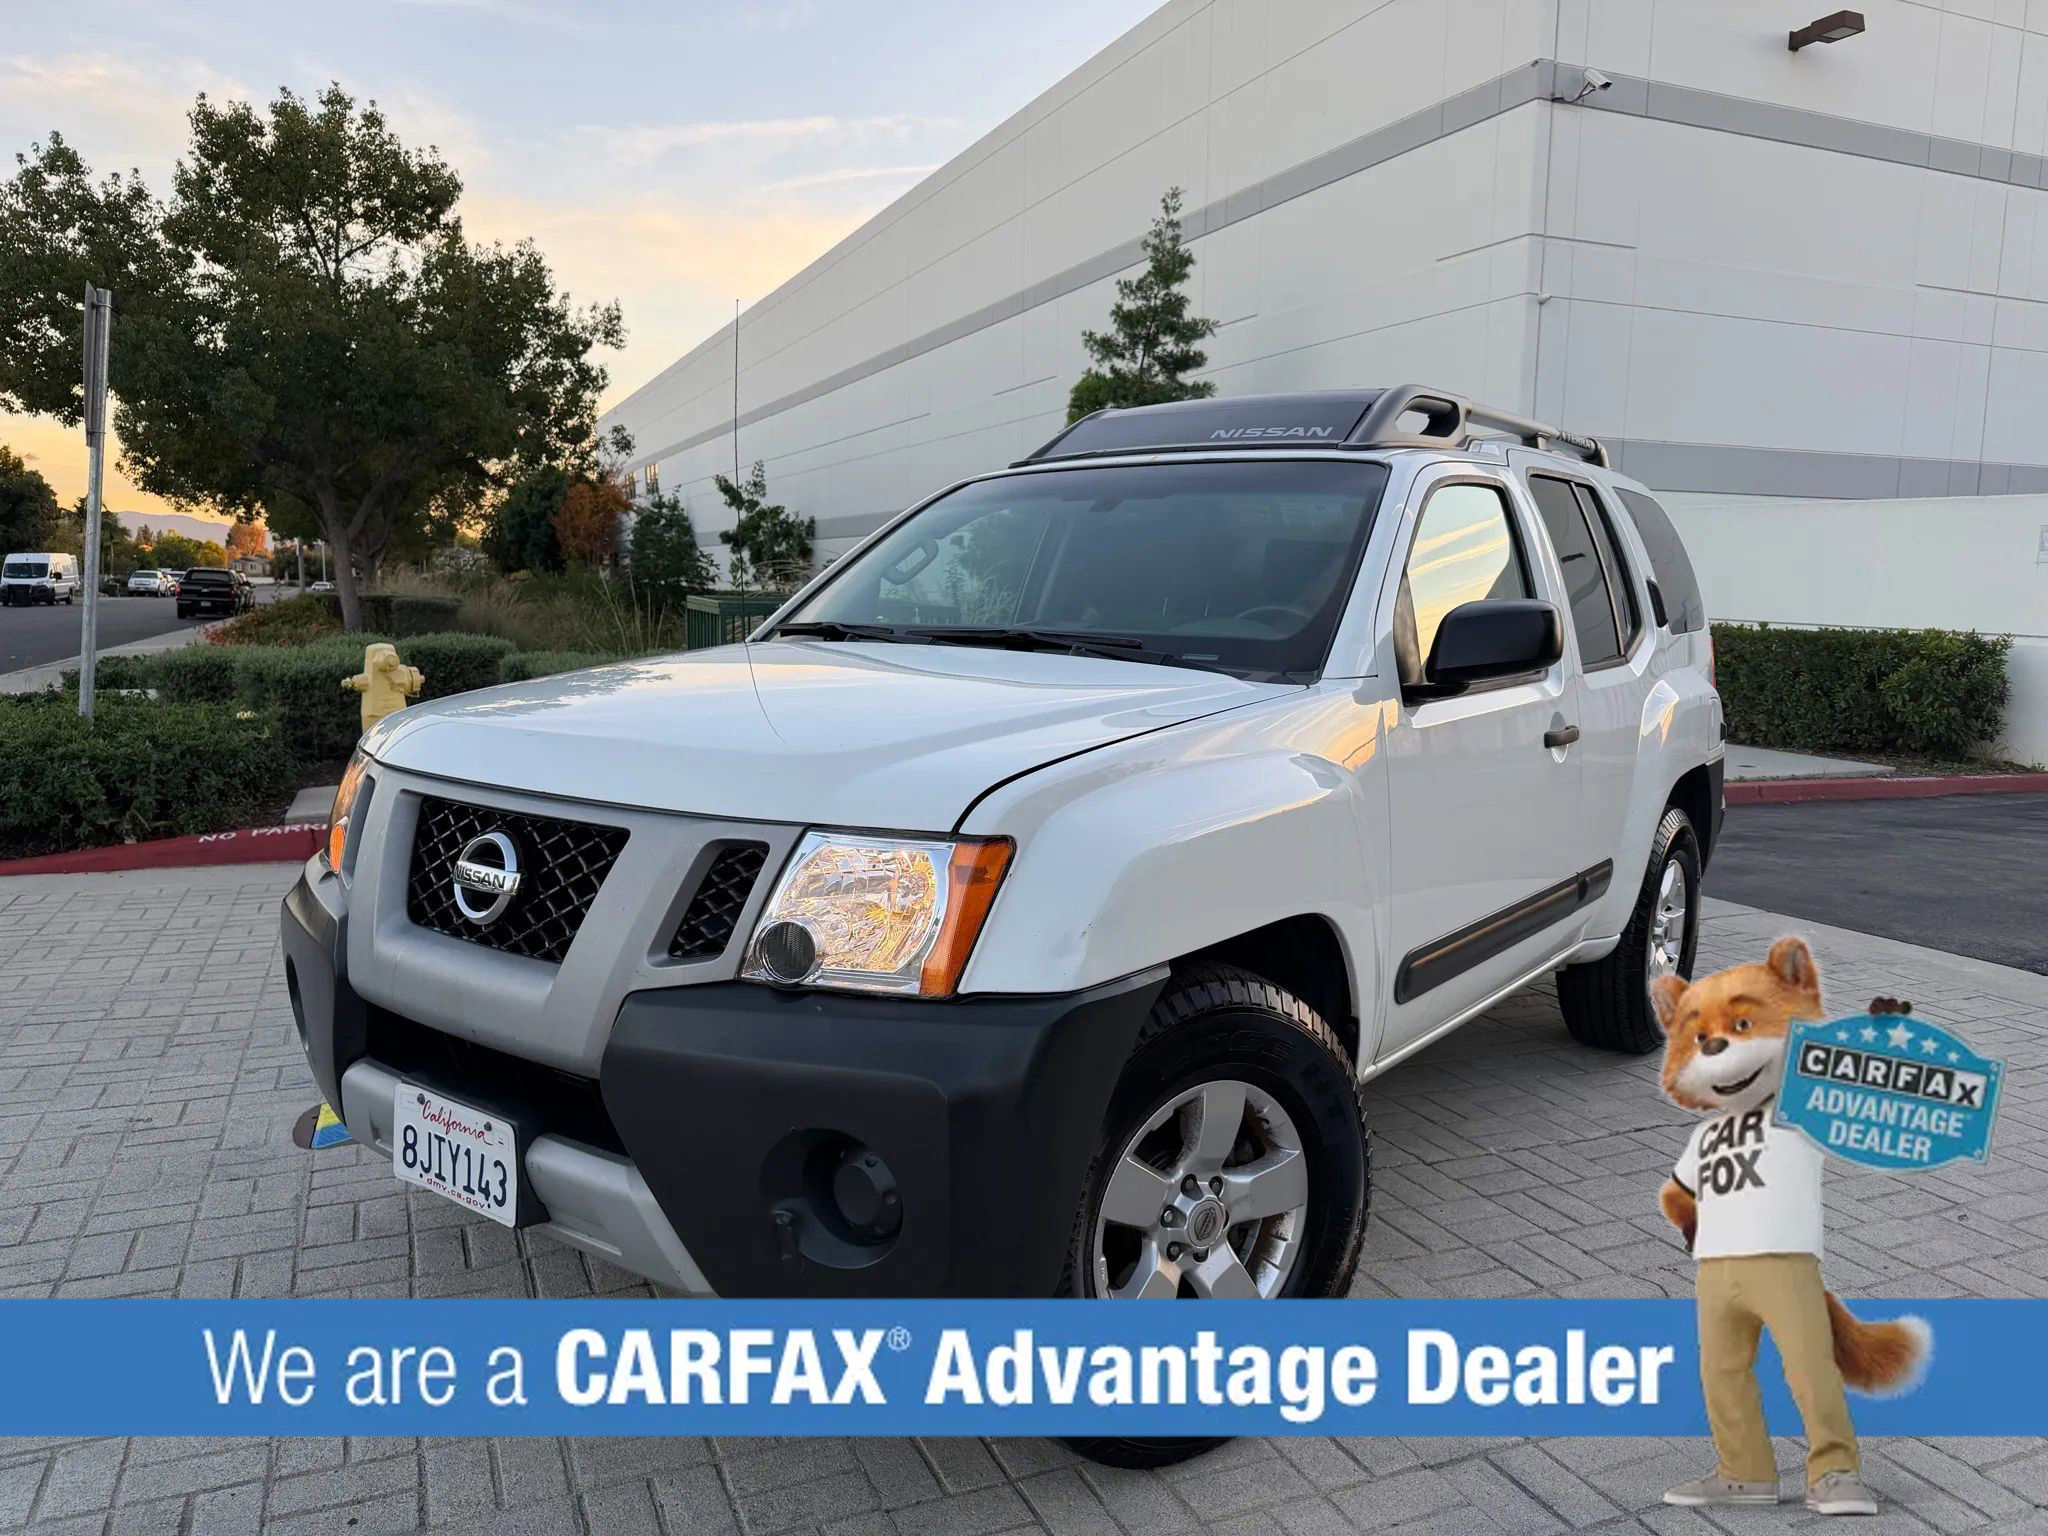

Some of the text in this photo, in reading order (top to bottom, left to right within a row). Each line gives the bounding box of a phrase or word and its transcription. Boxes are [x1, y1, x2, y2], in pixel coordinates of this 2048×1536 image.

[1210, 426, 1334, 439] NISSAN
[199, 823, 329, 843] NO PARKI
[455, 863, 506, 889] NISSAN
[422, 1100, 493, 1146] California
[426, 1177, 485, 1209] dmv.ca.gov
